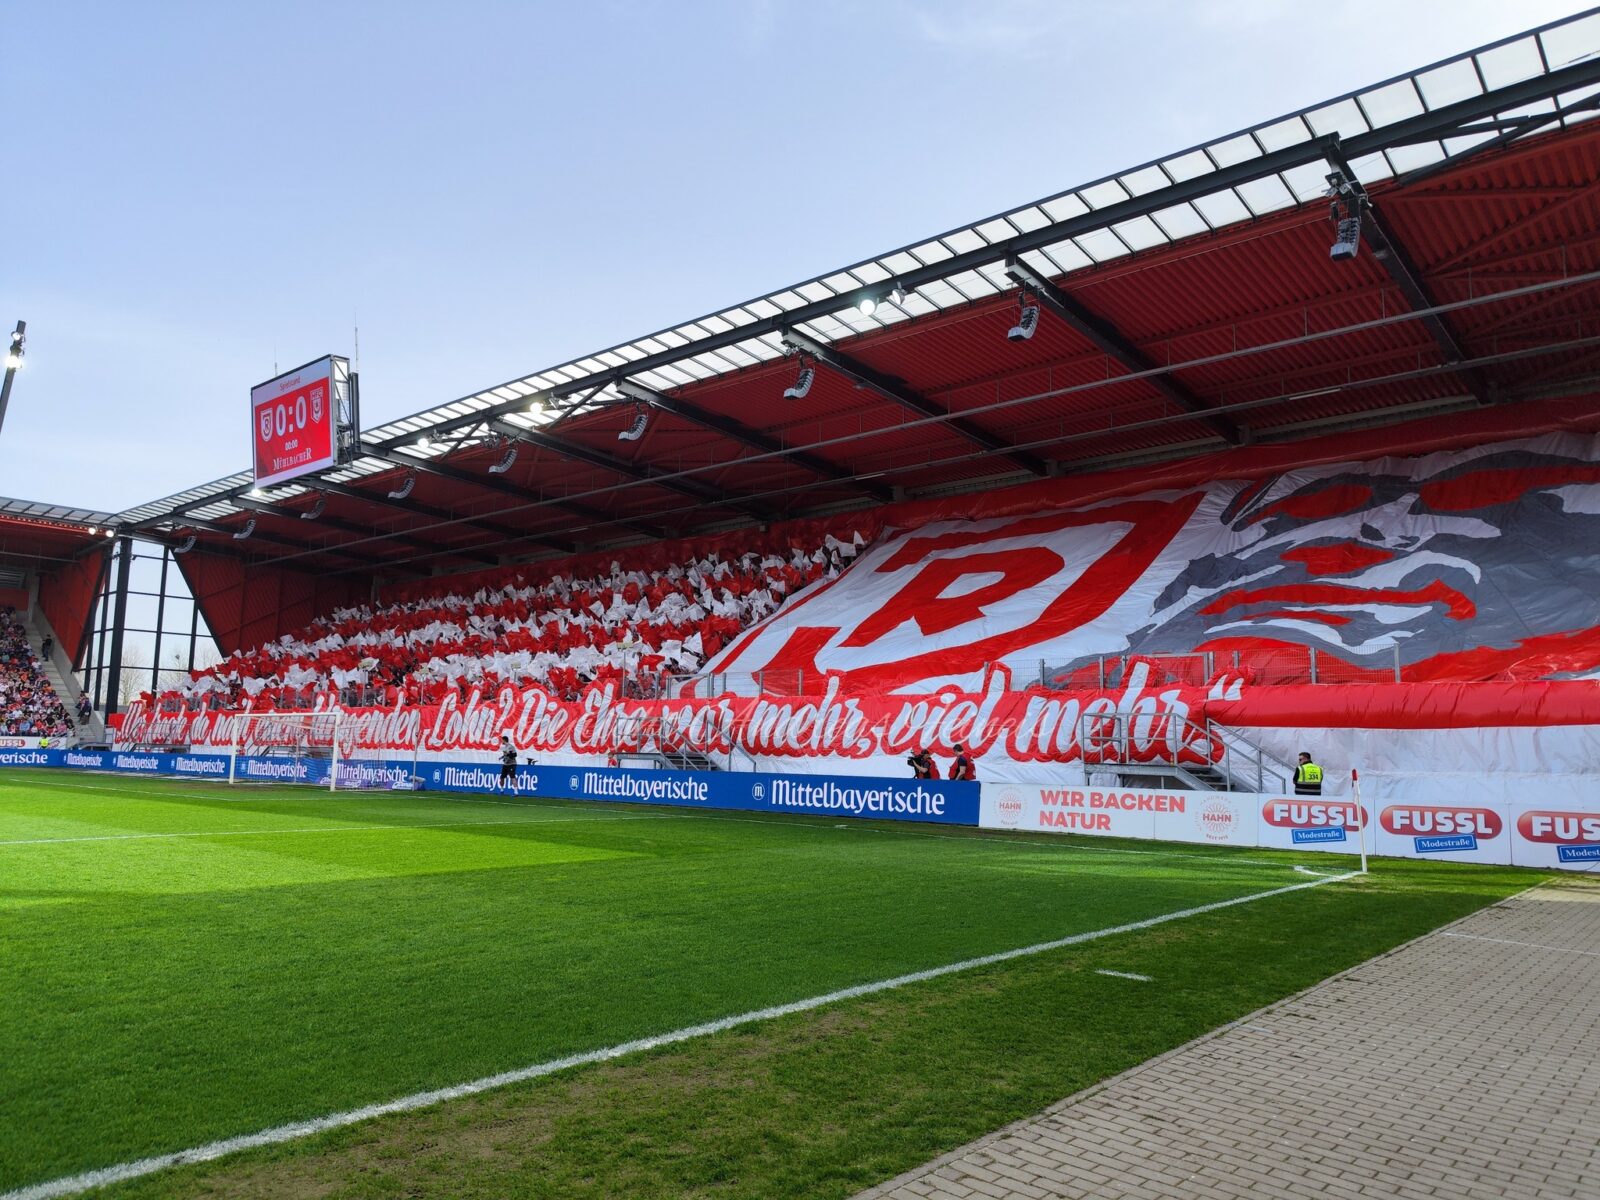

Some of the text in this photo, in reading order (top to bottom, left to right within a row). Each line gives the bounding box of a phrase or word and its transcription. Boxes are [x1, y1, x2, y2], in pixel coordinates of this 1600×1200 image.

[275, 395, 307, 437] 0:0
[428, 687, 514, 746] Lohn?
[516, 688, 569, 745] Die
[747, 676, 871, 755] mehr,
[889, 669, 1005, 750] viel
[0, 752, 48, 764] erische
[176, 757, 226, 774] Mittelbayerische
[247, 759, 308, 779] Mittelbayerische
[583, 772, 708, 801] Mittelbayerische
[772, 779, 945, 815] Mittelbayerische
[999, 801, 1022, 810] HAHN
[1040, 789, 1084, 808] WIR
[1090, 791, 1186, 813] BACKEN
[1039, 810, 1112, 831] NATUR
[1202, 813, 1232, 822] HAHN
[1273, 803, 1360, 826] FUSSL
[1392, 809, 1493, 835] FUSSL
[1297, 829, 1340, 839] Modestraße
[1531, 815, 1600, 841] FUS
[1421, 838, 1470, 848] Modestraße
